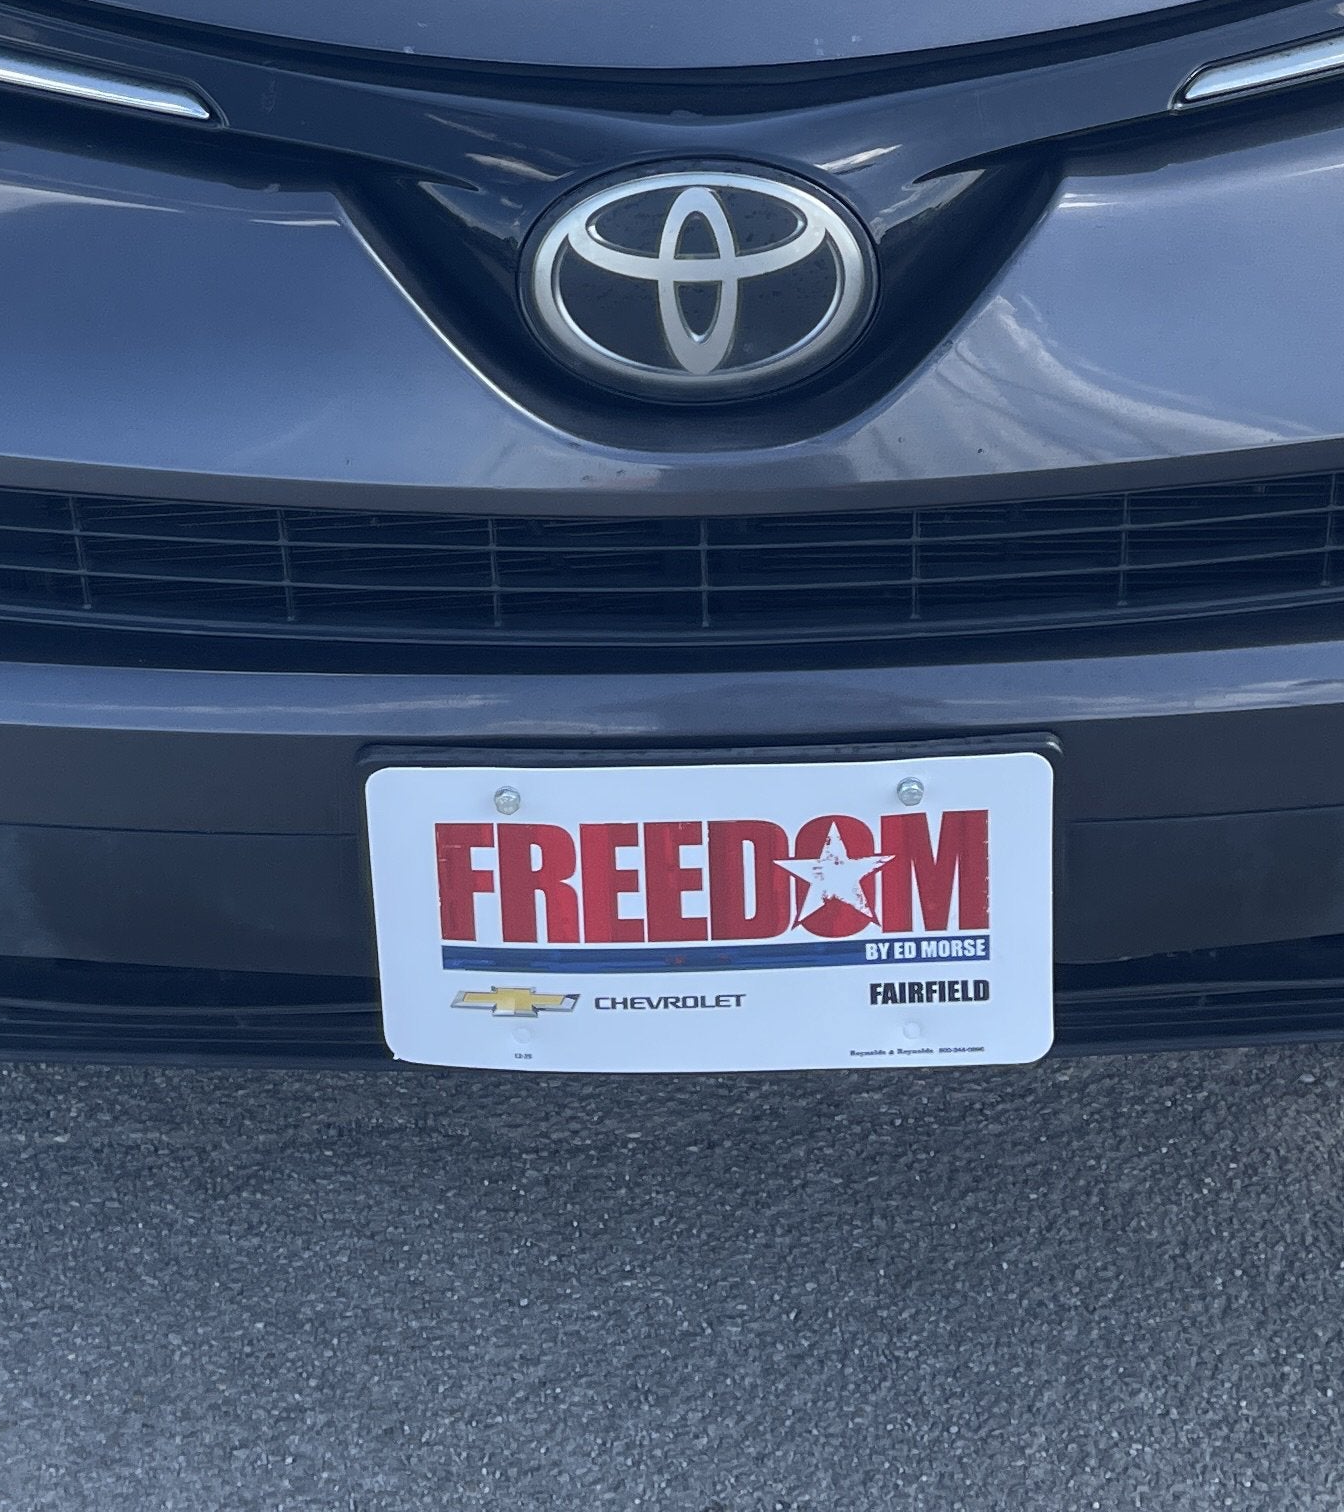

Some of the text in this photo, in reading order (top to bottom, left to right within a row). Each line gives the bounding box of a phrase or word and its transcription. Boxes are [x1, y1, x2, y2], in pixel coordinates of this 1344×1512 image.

[434, 809, 990, 944] FREEDOM
[865, 938, 986, 960] BY ED MORSE
[594, 993, 747, 1010] CHEVROLET
[869, 979, 990, 1005] FAIRFIELD
